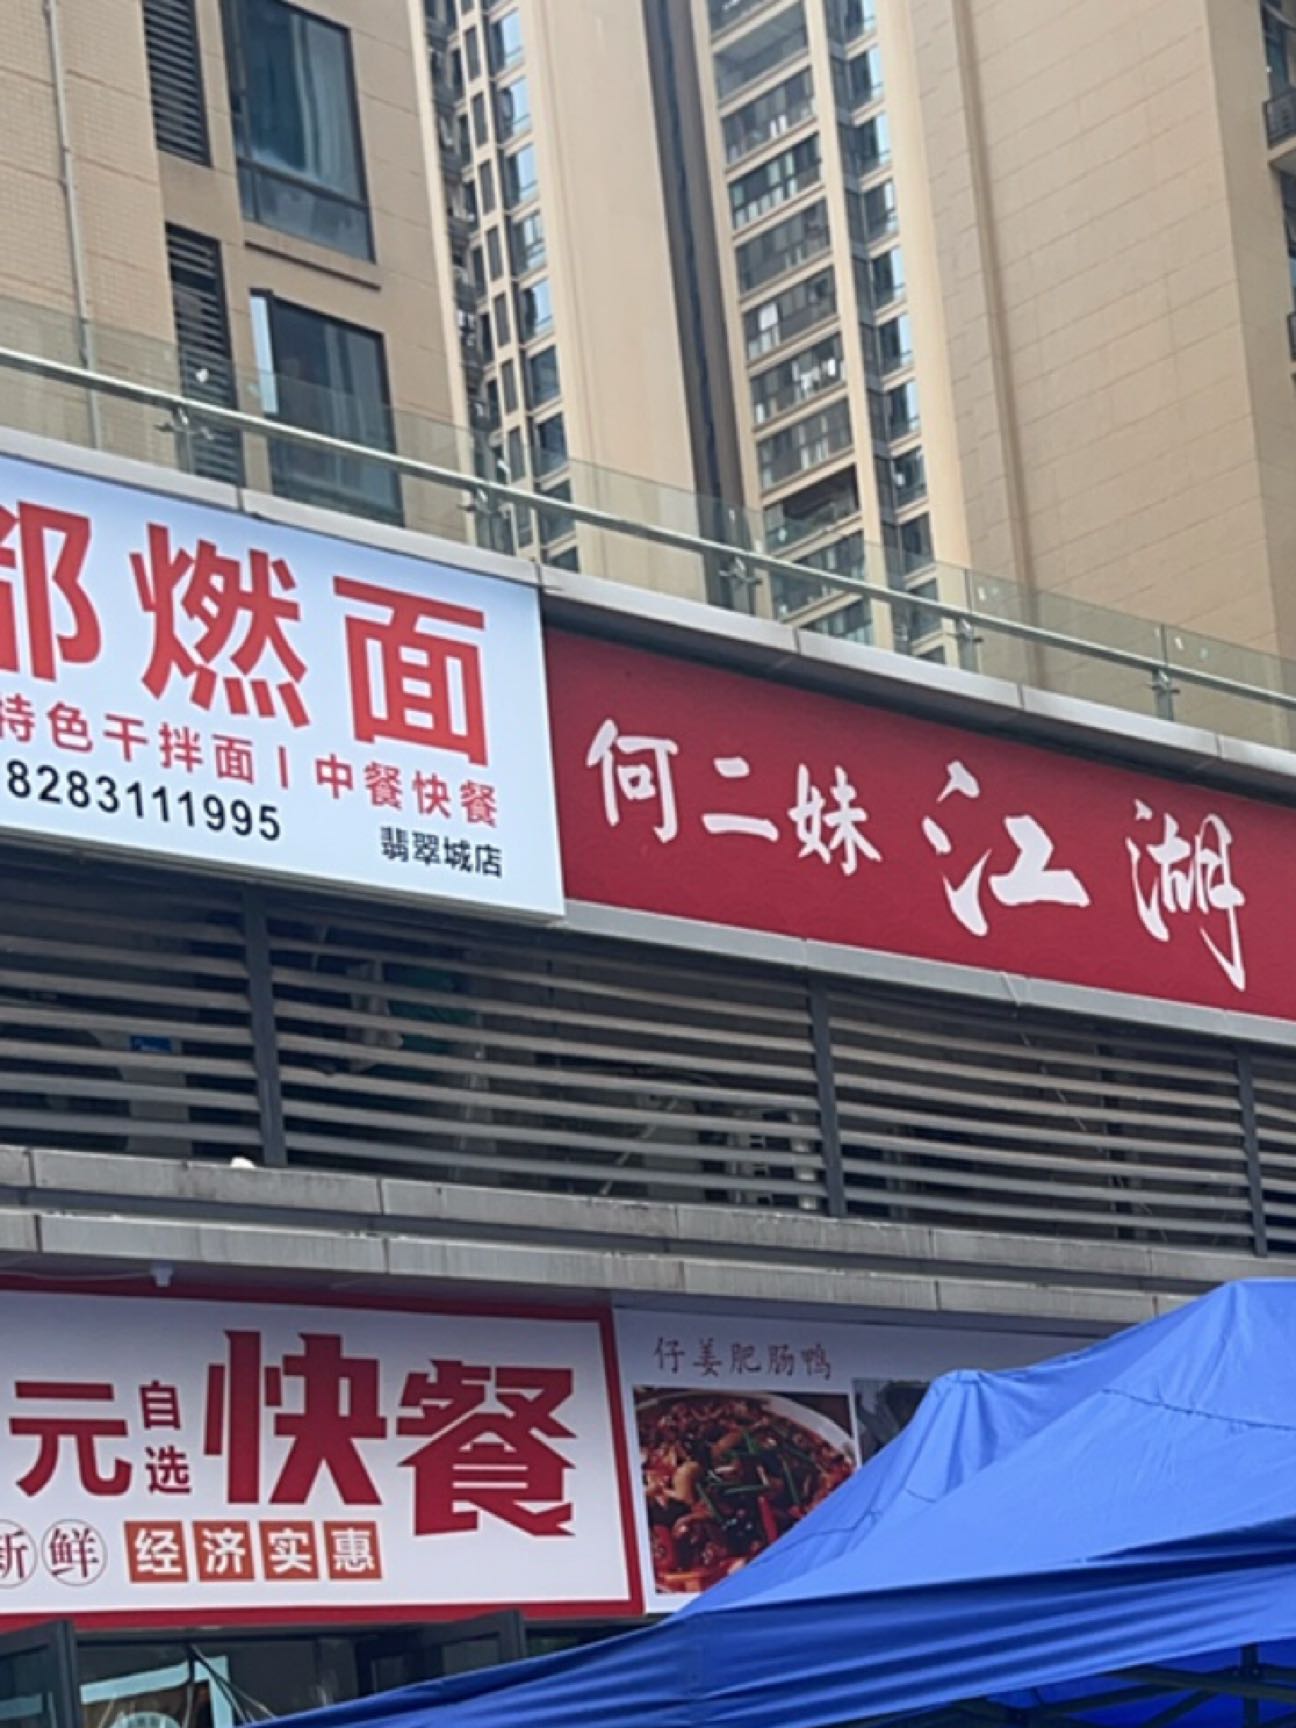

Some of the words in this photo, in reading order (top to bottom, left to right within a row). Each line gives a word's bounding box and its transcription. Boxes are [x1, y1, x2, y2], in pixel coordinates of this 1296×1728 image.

[7, 759, 282, 841] 8283111995
[380, 826, 503, 879] 翡翠城店
[654, 1336, 832, 1381] 仔姜肥肠鸭
[203, 1329, 577, 1537] 快餐
[134, 1527, 377, 1578] 经济实惠
